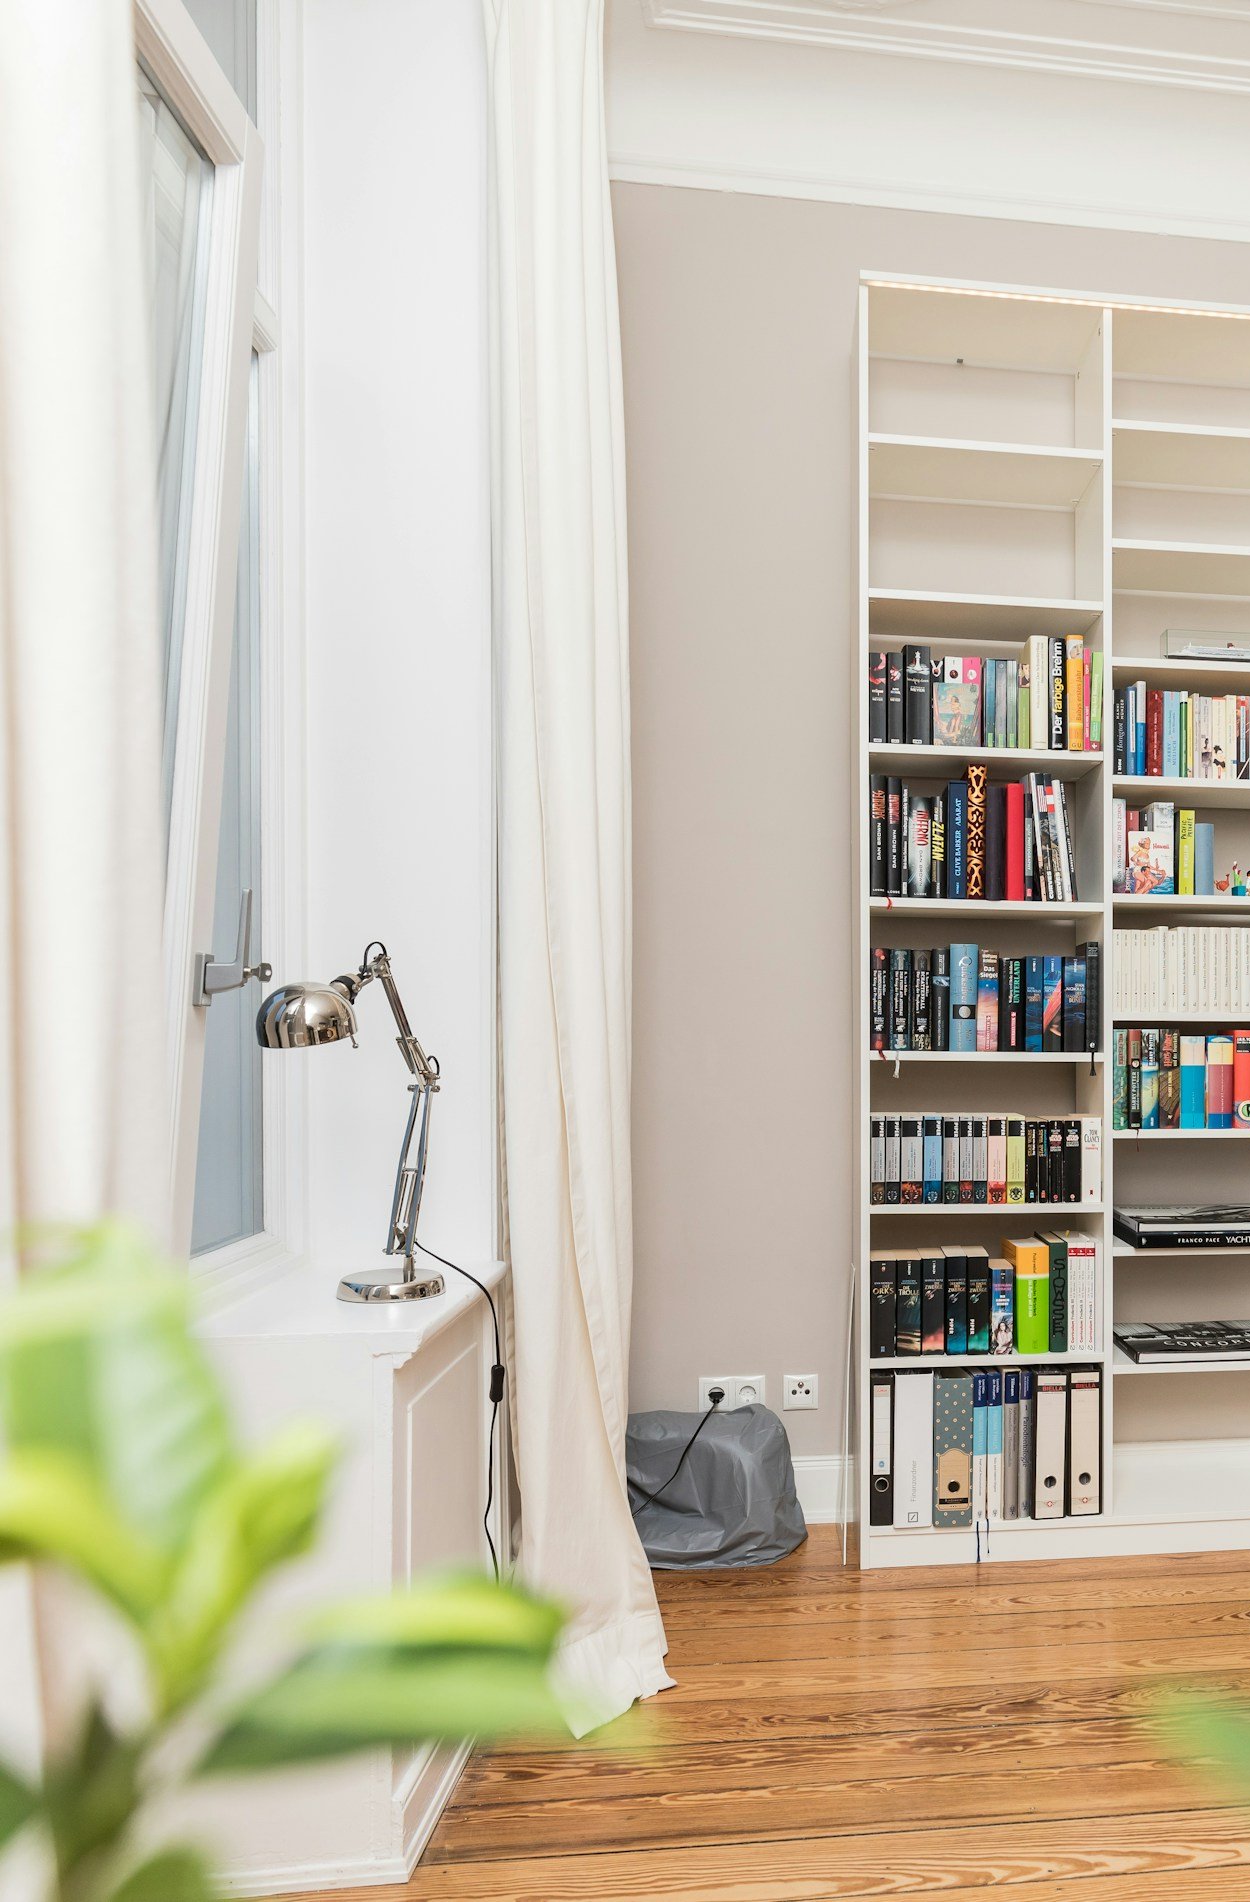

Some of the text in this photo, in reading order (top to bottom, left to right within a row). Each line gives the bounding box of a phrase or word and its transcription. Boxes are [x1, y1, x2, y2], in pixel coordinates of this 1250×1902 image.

[1052, 641, 1064, 734] Der farbige Brehm
[1116, 722, 1124, 751] Honigtot
[932, 820, 945, 861] ZLATAN
[954, 799, 962, 876] CLIVE BARKER ABARAT
[872, 1287, 895, 1295] ORKS
[1021, 1415, 1031, 1468] Parodontologie
[910, 1460, 918, 1502] Finanzordner
